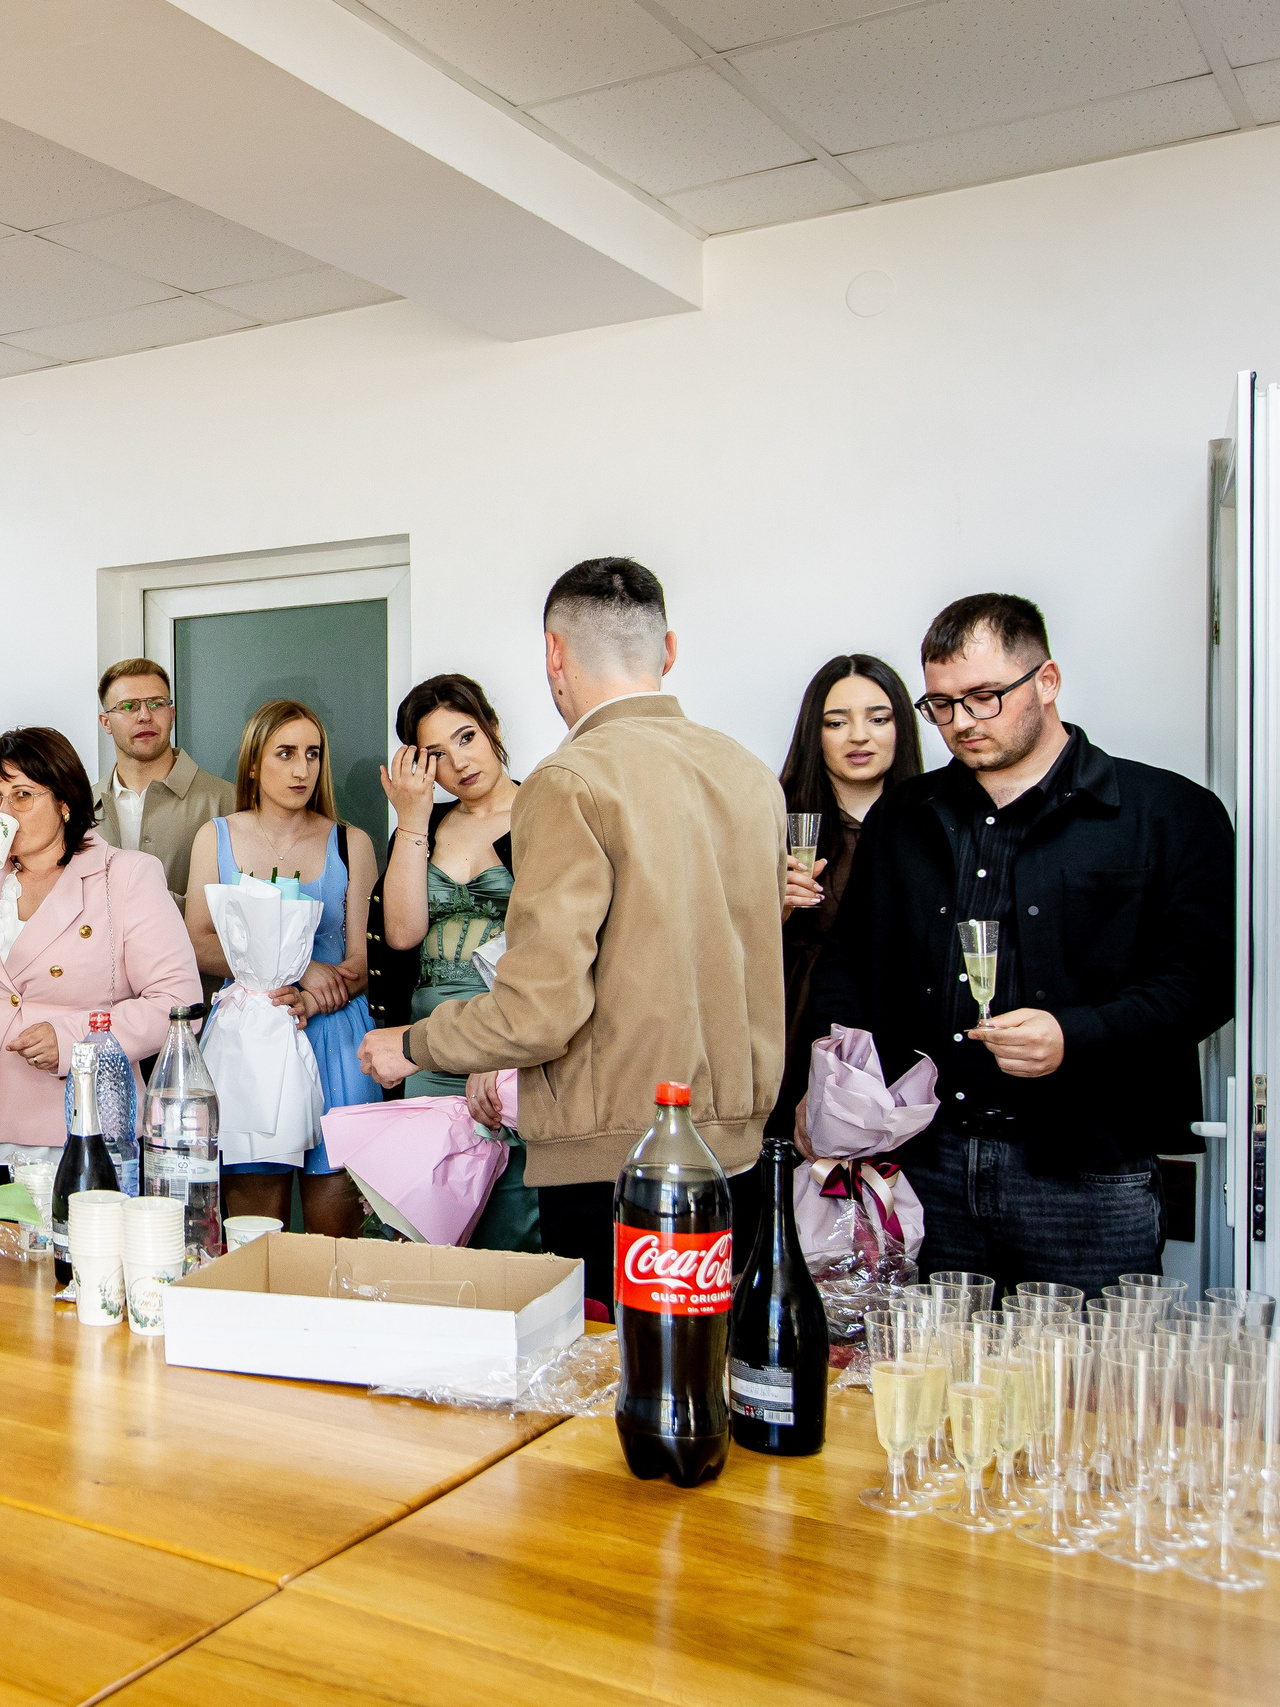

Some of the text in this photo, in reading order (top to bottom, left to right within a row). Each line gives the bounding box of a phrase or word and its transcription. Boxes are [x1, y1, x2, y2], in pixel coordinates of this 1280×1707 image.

[624, 1232, 733, 1290] Coca-Col
[651, 1289, 732, 1304] GUST ORIGINA
